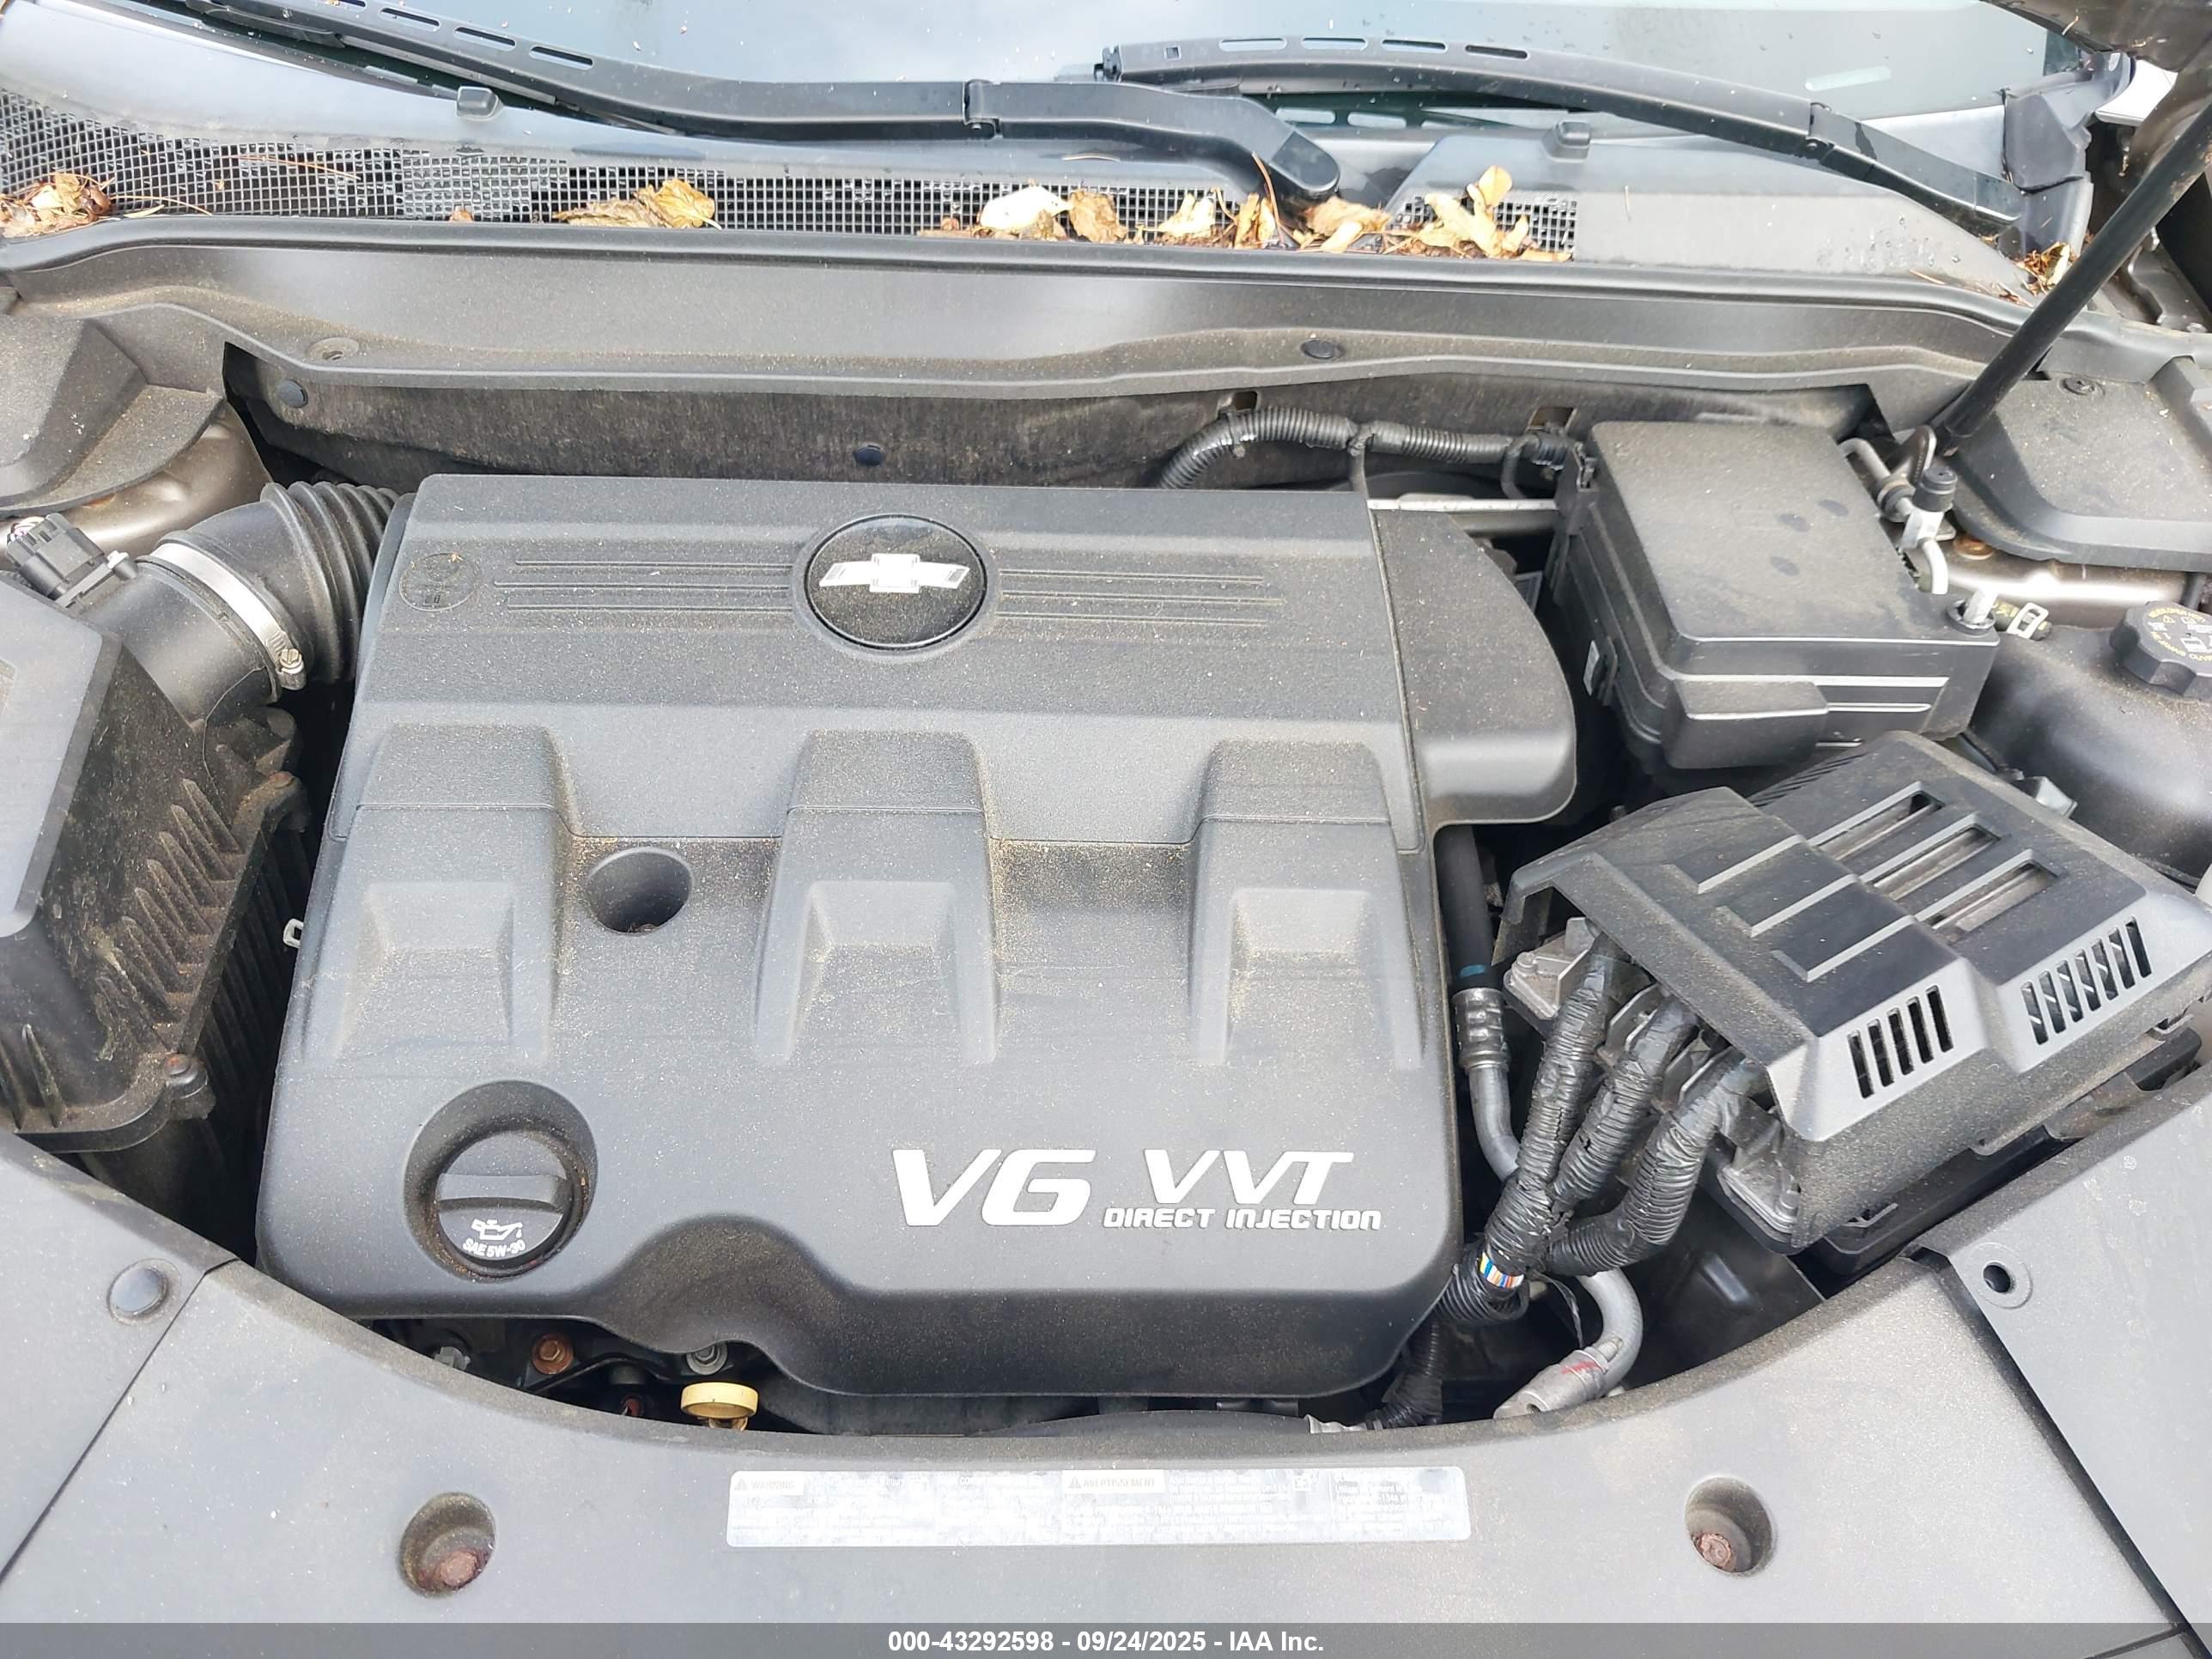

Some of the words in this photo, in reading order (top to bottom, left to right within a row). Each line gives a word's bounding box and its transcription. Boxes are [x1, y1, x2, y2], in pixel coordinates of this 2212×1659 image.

[892, 1149, 1096, 1226] V6
[1143, 1149, 1354, 1205] VVT
[1103, 1208, 1215, 1228] DIRECT
[463, 1237, 487, 1256] SAE
[486, 1239, 526, 1257] 5W-30
[750, 1479, 796, 1492] WARNING
